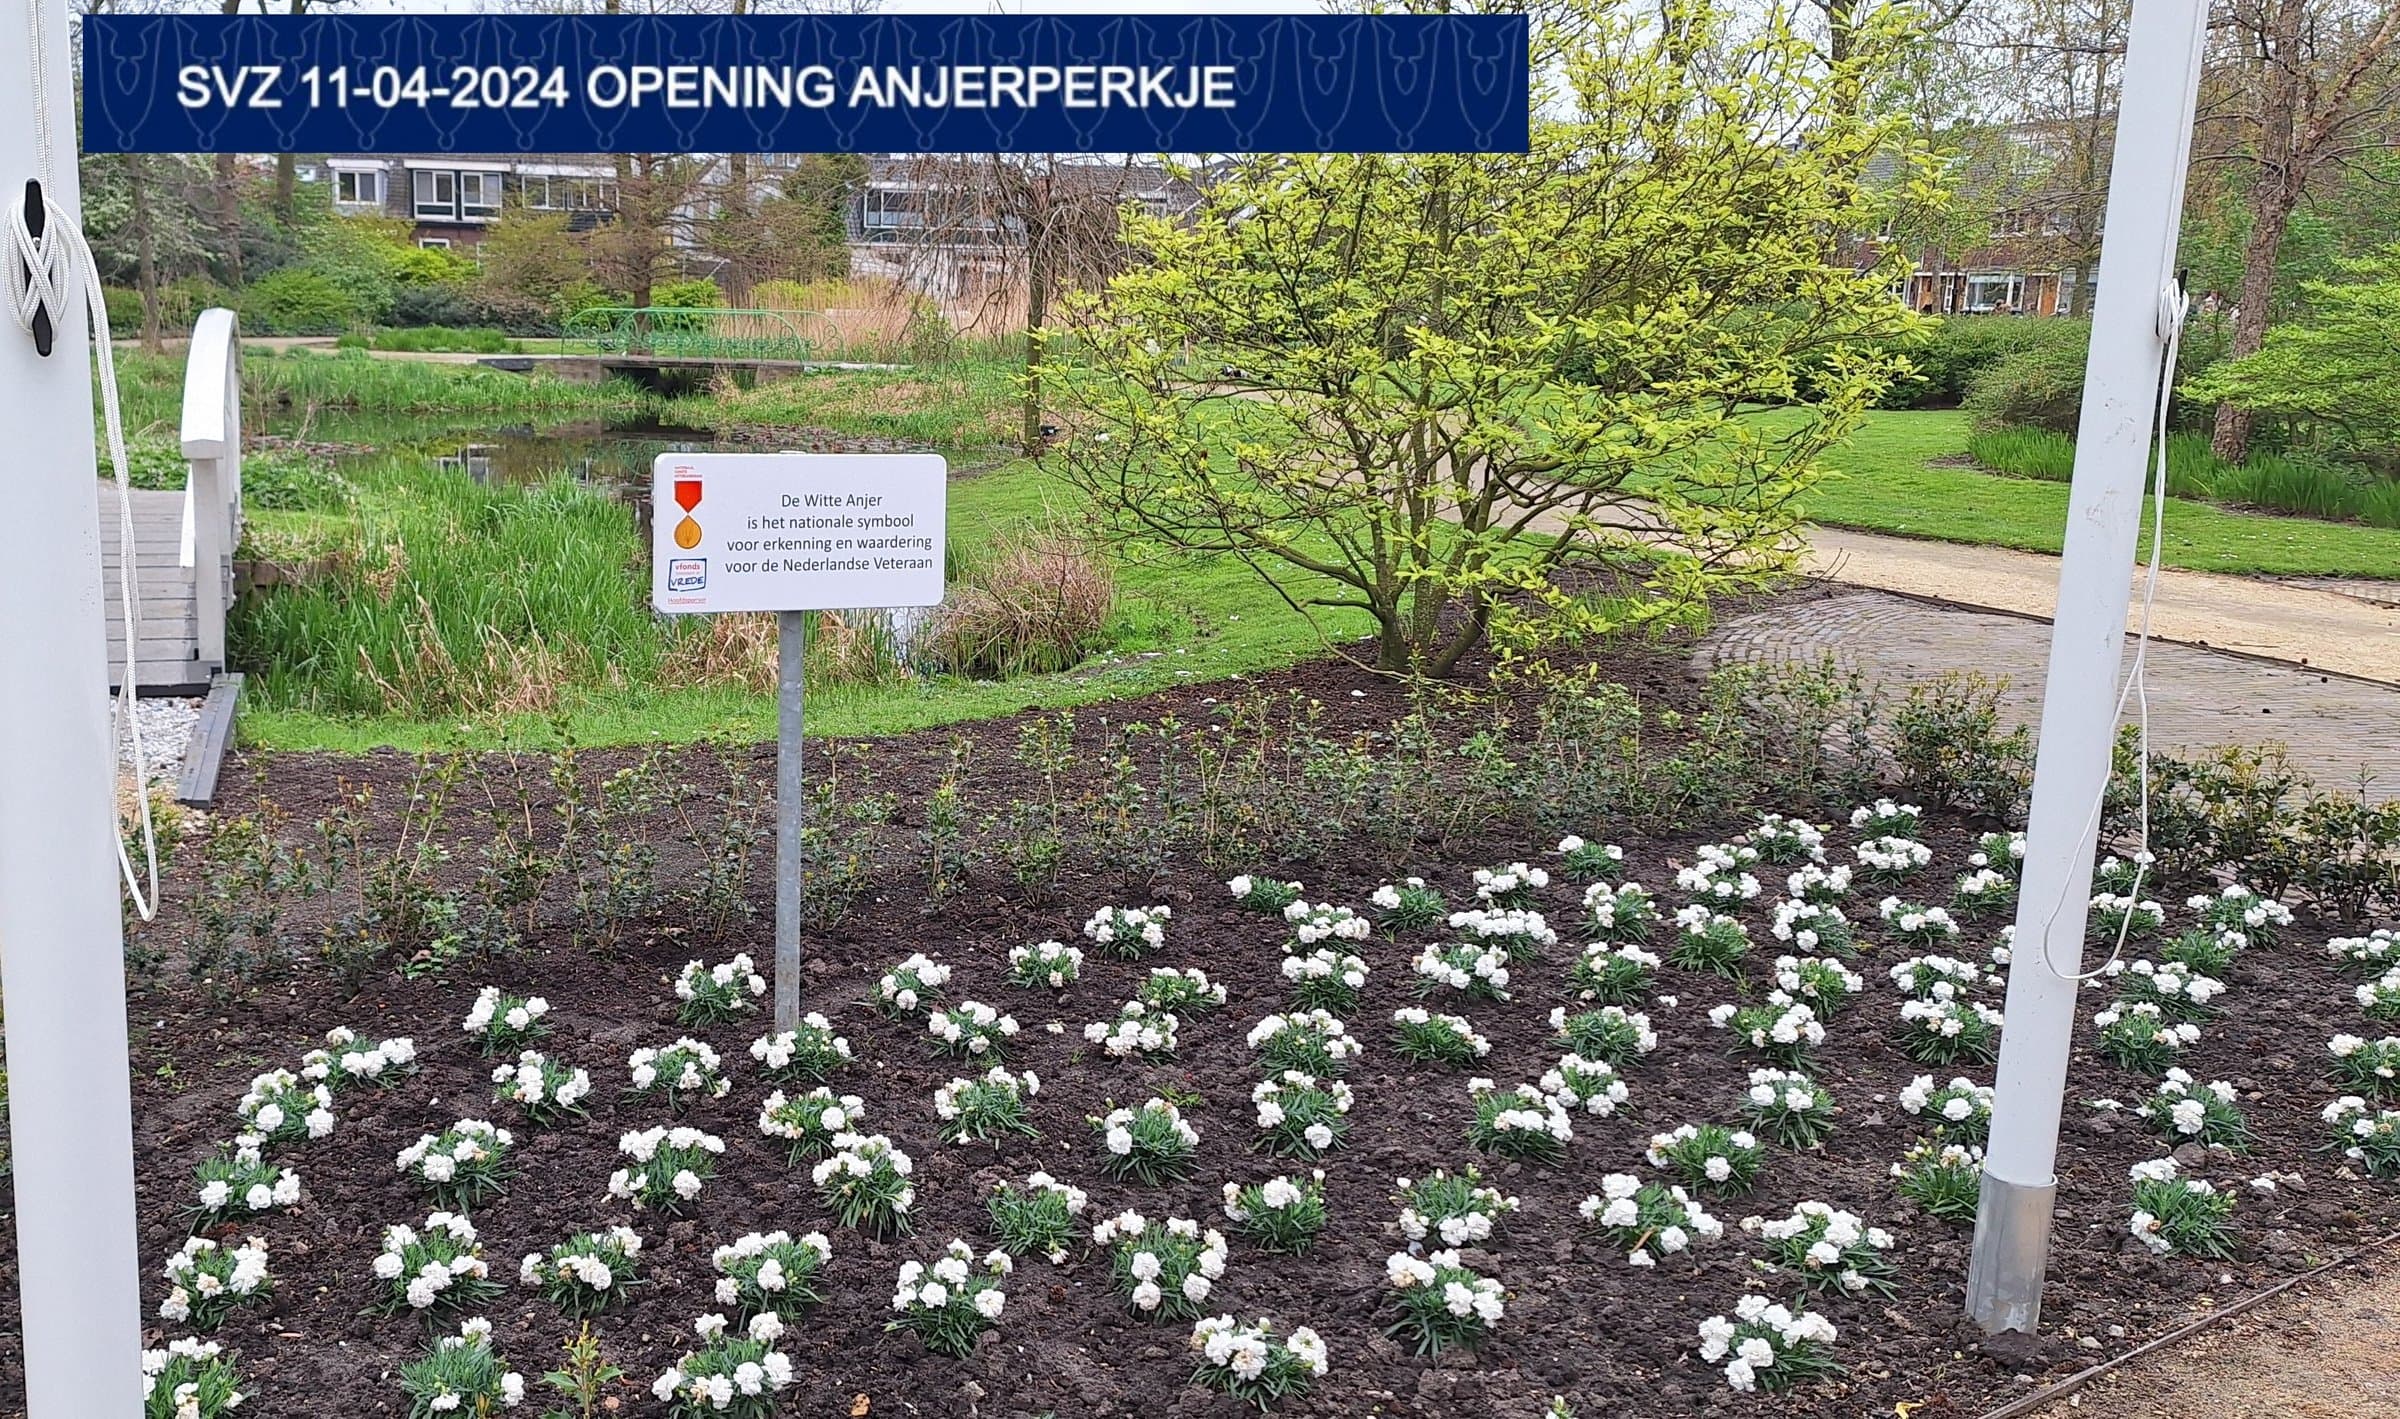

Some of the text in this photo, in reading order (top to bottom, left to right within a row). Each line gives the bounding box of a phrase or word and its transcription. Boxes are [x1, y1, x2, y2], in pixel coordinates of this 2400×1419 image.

[781, 493, 883, 510] De Witte Anjer
[747, 513, 914, 532] is het nationale symbool
[726, 534, 933, 554] voor erkenning en waardering
[725, 556, 933, 573] voor de Nederlandse Veteraan
[670, 576, 704, 587] VREDE
